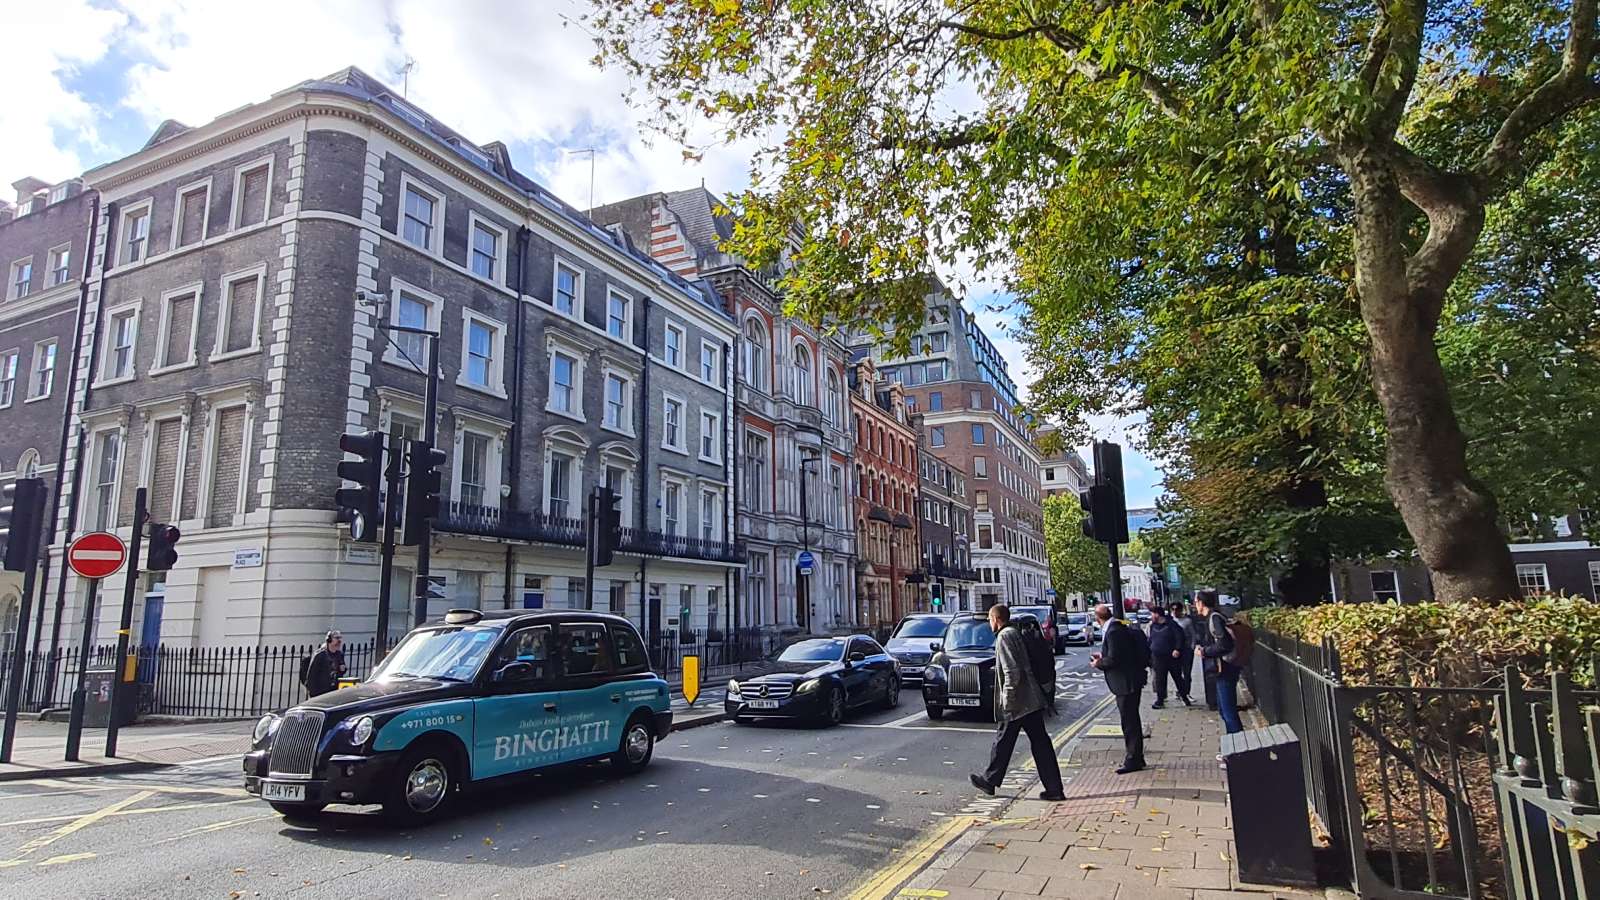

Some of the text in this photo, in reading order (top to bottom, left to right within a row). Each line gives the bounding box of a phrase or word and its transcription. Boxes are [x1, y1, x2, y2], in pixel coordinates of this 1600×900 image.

[401, 719, 423, 729] +971
[426, 717, 444, 727] 800
[495, 720, 610, 760] BINGHATTI
[265, 783, 300, 798] LR14 YFV
